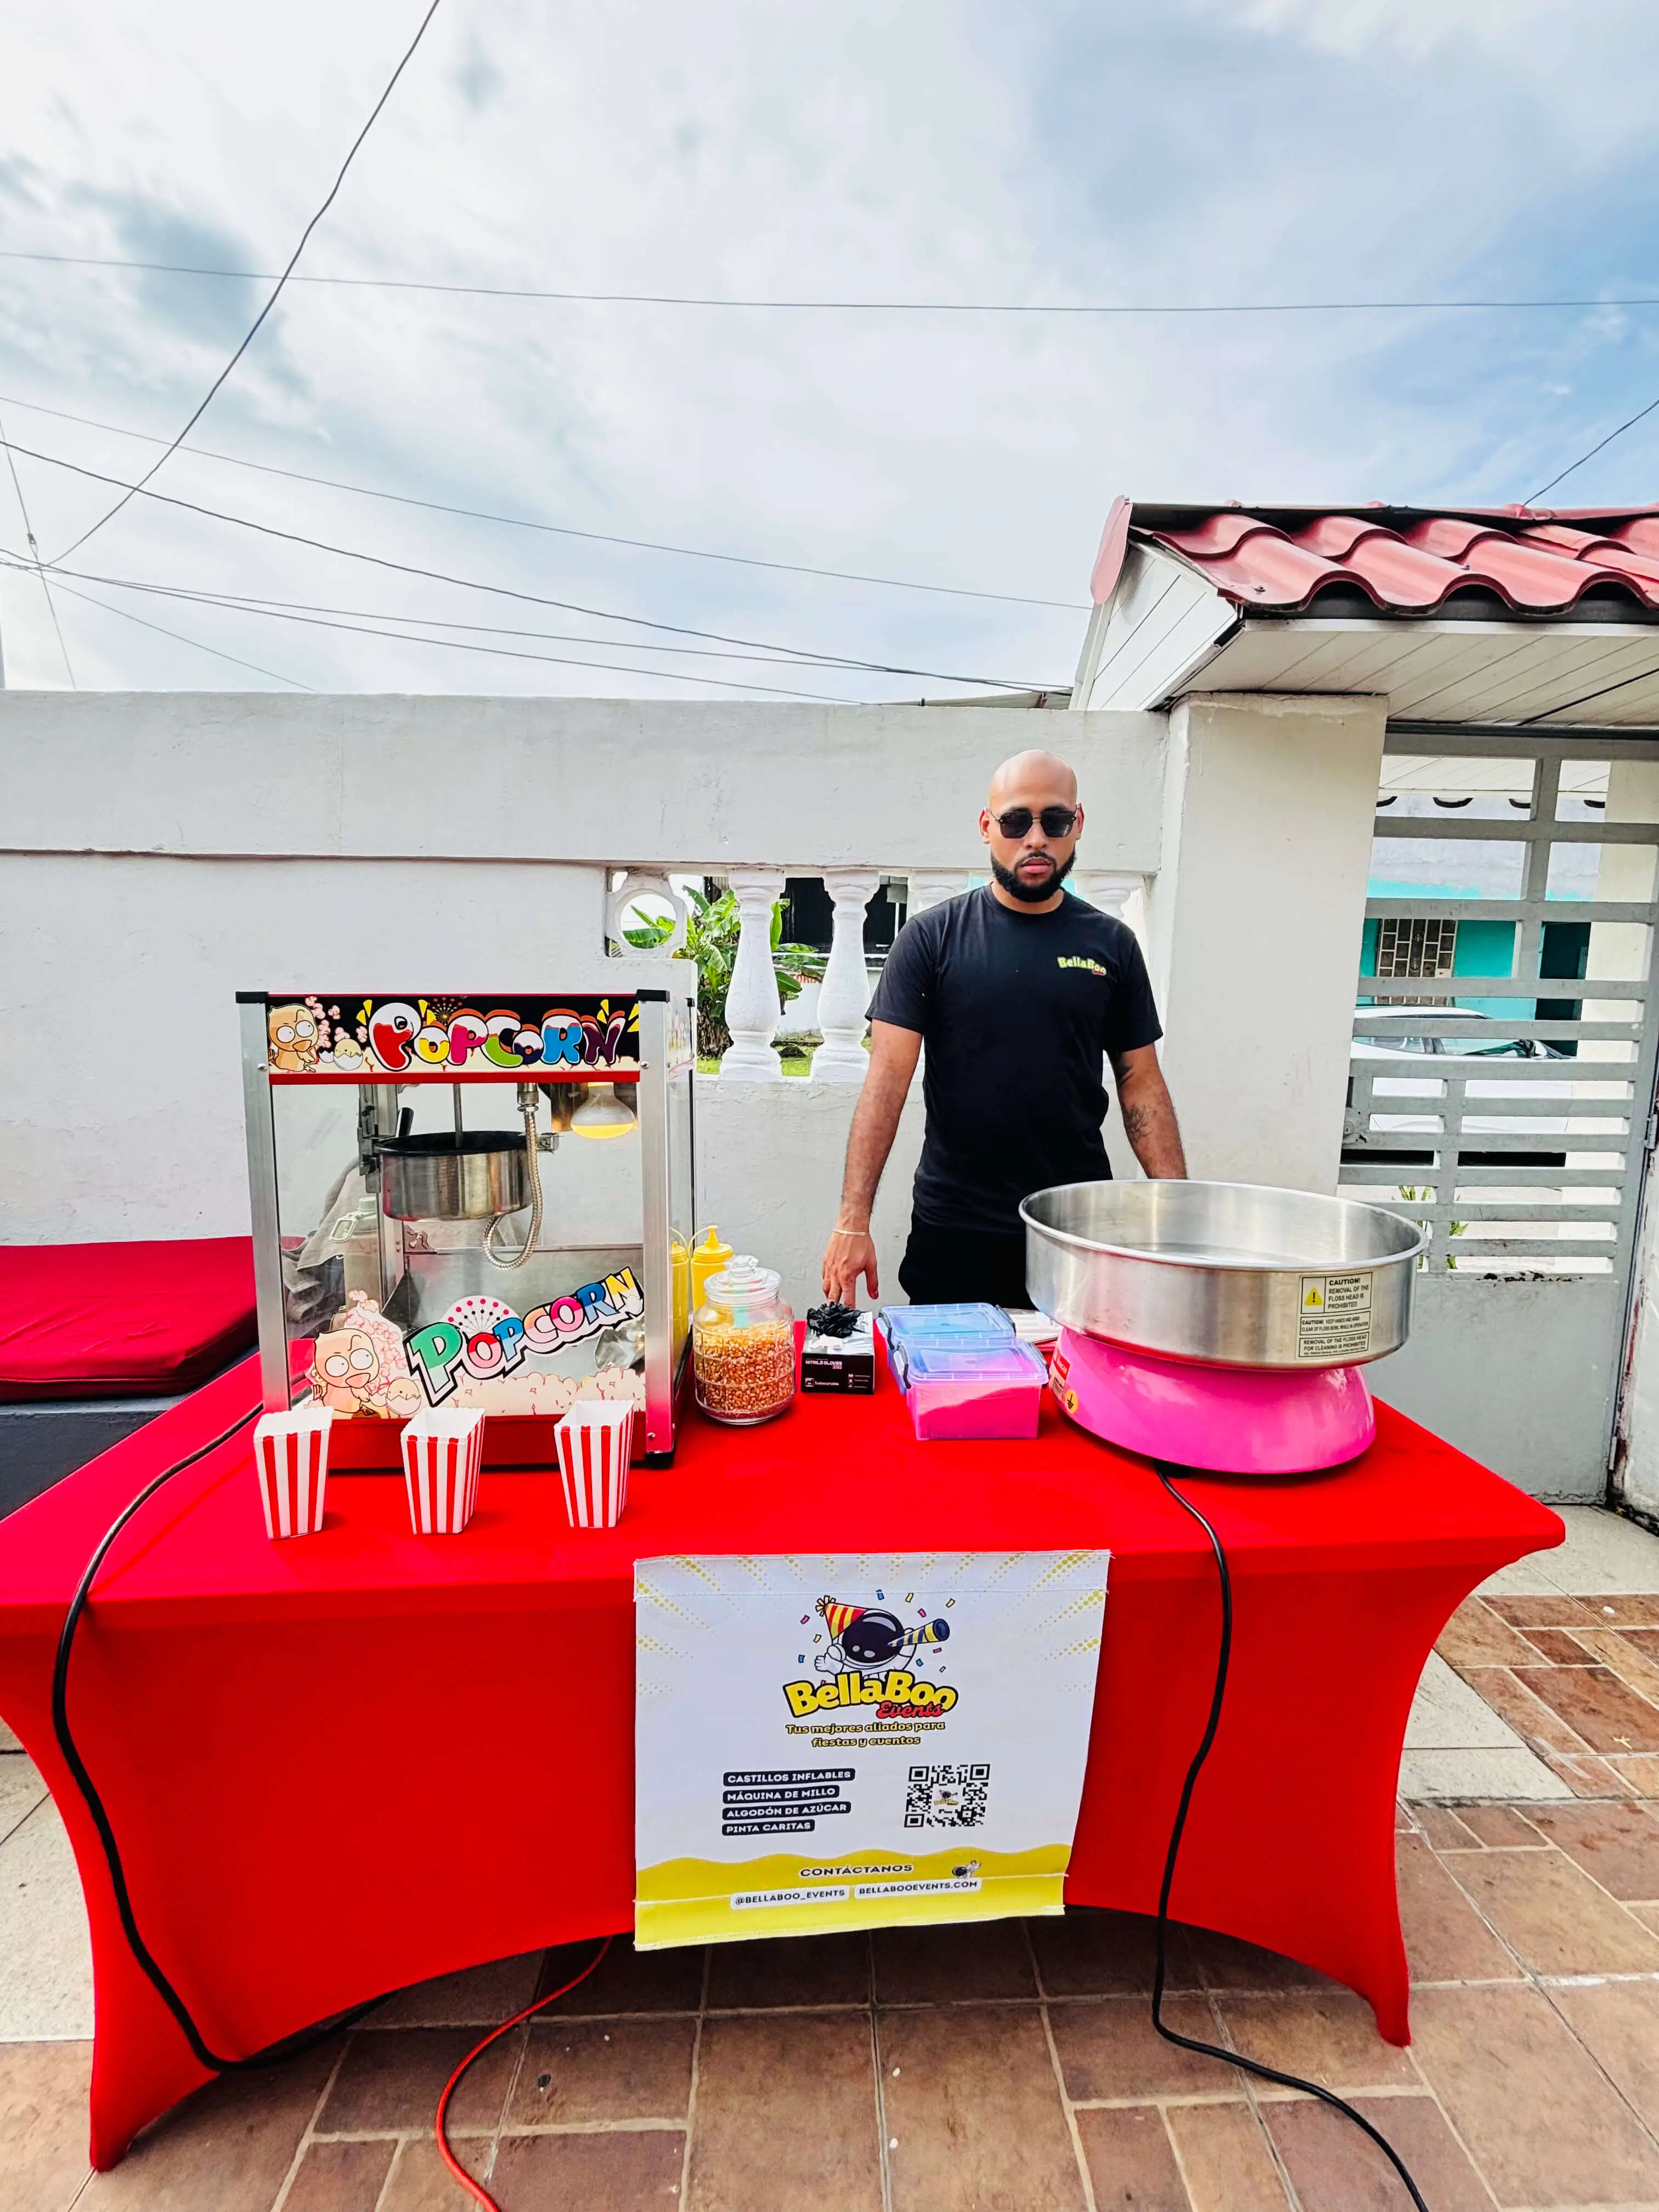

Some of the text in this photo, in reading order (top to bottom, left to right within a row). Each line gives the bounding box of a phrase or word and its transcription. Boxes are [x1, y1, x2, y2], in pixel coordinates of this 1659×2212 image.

[1057, 956, 1107, 975] BellaBoo
[404, 1266, 644, 1407] POPCORN
[783, 1669, 958, 1718] BellaBoo
[876, 1701, 944, 1719] Events
[786, 1721, 945, 1735] Tus mejores aliados para
[811, 1736, 921, 1748] fiestas y eventos
[727, 1771, 850, 1784] CASTILLOS INFLABLES
[727, 1791, 781, 1801] MÁQUINA
[801, 1787, 836, 1798] MILLO
[726, 1807, 782, 1818] ALGODÓN
[802, 1803, 847, 1814] AZÚCAR
[726, 1822, 811, 1833] PINTA CARITAS
[800, 1864, 913, 1877] CONTÁCTANOS
[735, 1880, 978, 1905] @BELLABOO_EVENTS BELLABOOEVENTS.COM
